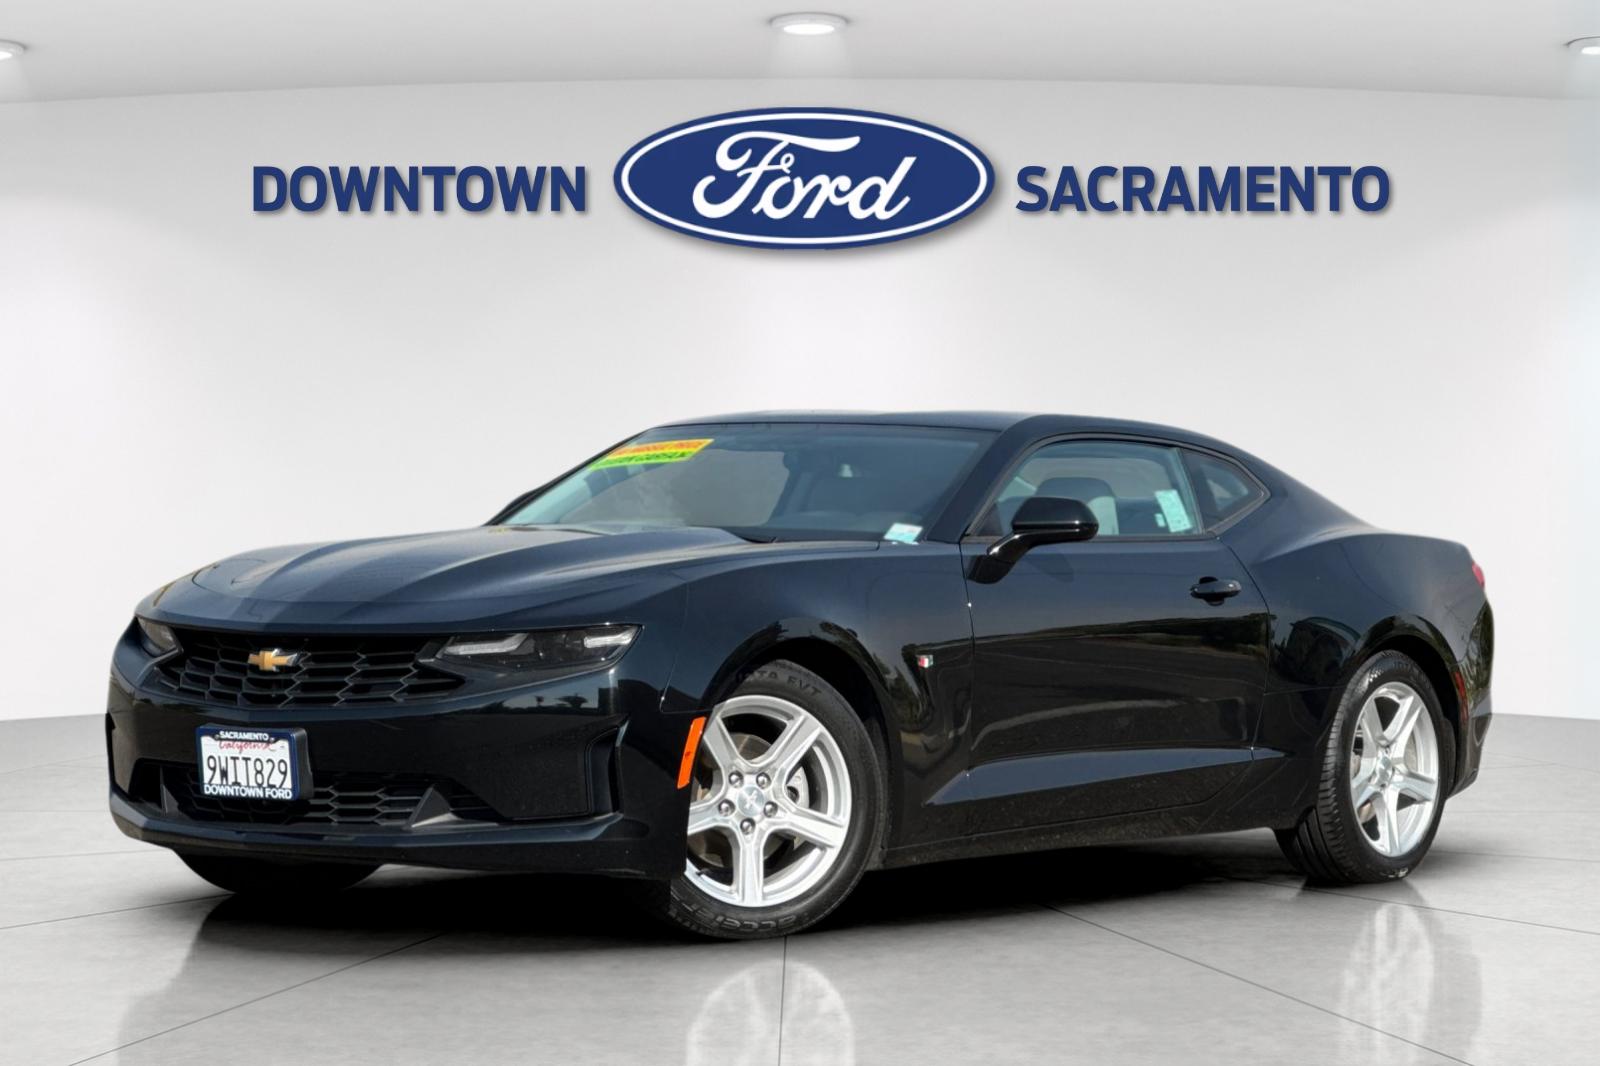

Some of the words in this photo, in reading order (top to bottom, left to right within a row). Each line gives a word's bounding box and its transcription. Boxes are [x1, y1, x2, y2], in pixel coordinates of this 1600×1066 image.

[252, 165, 585, 212] DOWNTOWN
[692, 131, 917, 220] Ford
[1016, 165, 1390, 212] SACRAMENTO
[219, 730, 269, 741] SACRAMENTO
[207, 755, 288, 788] 9WIT829
[204, 784, 264, 798] DOWNTOWN
[265, 788, 293, 800] FORD
